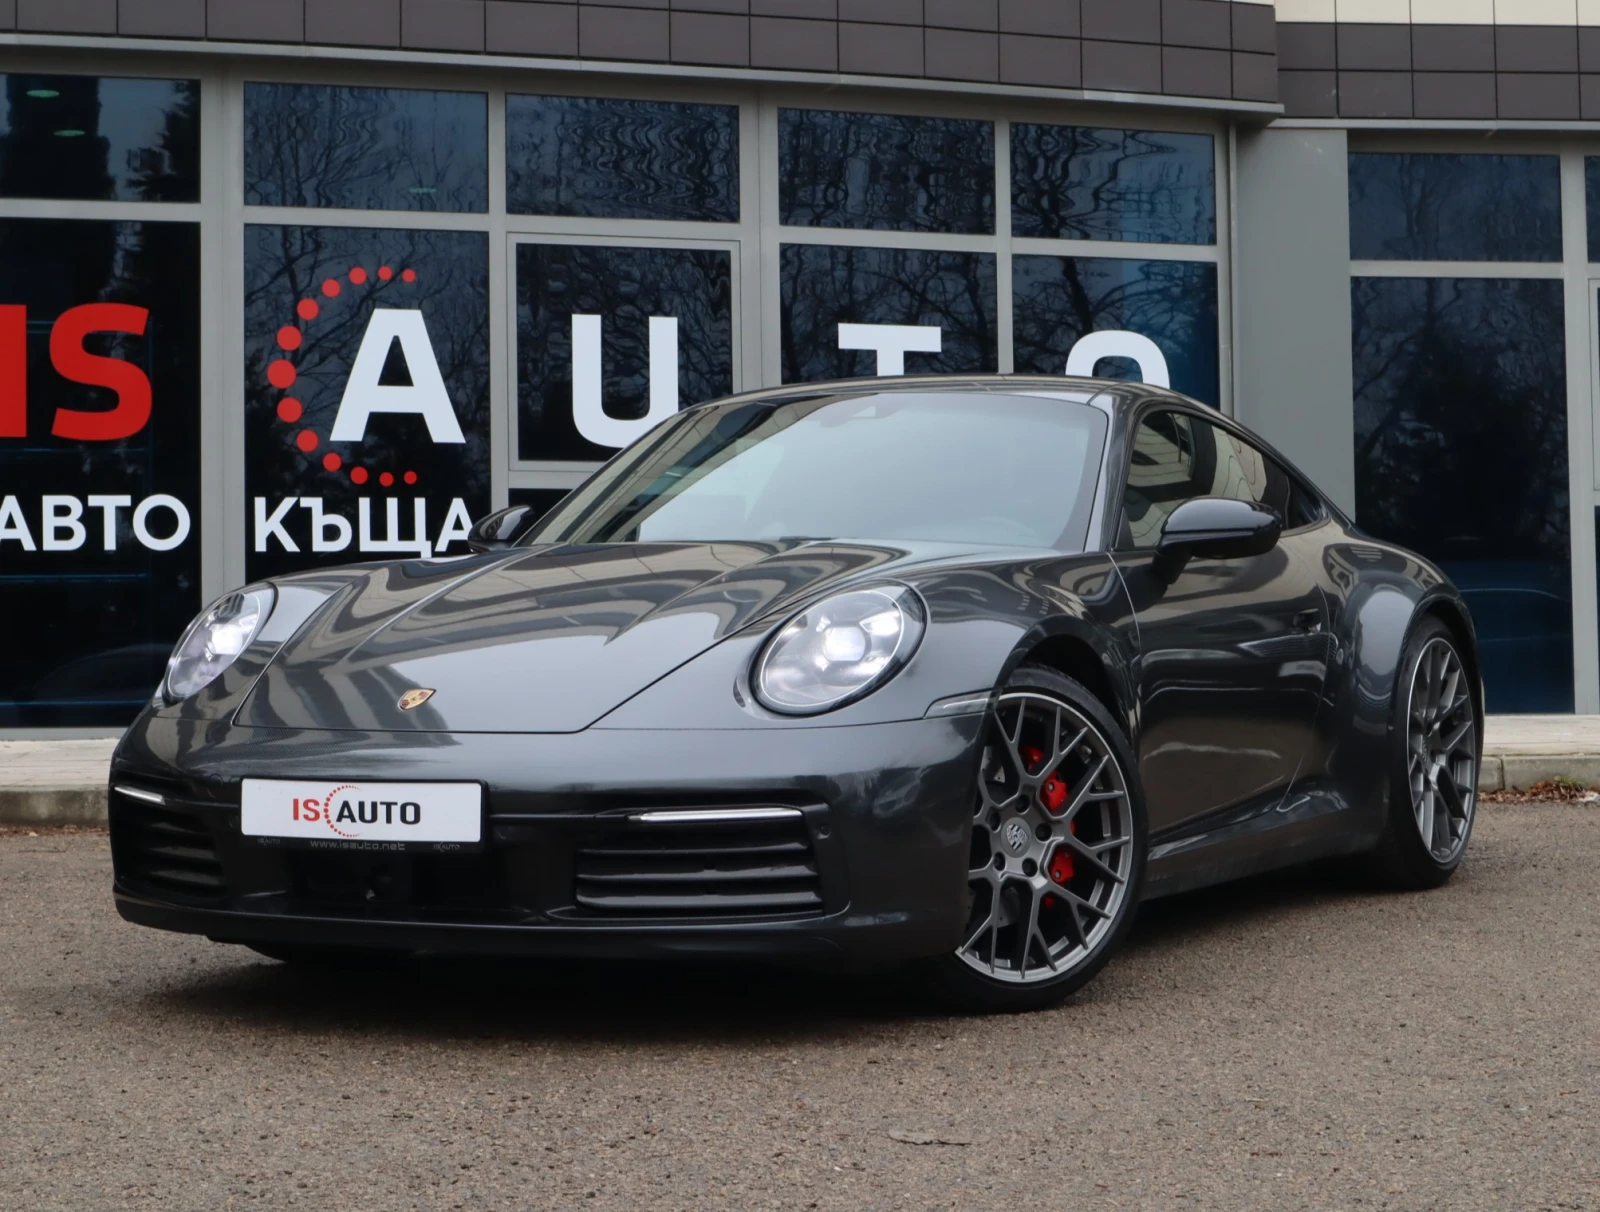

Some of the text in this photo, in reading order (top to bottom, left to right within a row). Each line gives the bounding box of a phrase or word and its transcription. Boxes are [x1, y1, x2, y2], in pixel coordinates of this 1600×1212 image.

[0, 303, 152, 440] IS
[0, 493, 475, 558] АВТО КЪЩА
[293, 798, 421, 825] IS AUTO
[310, 840, 405, 851] www.isauto.net
